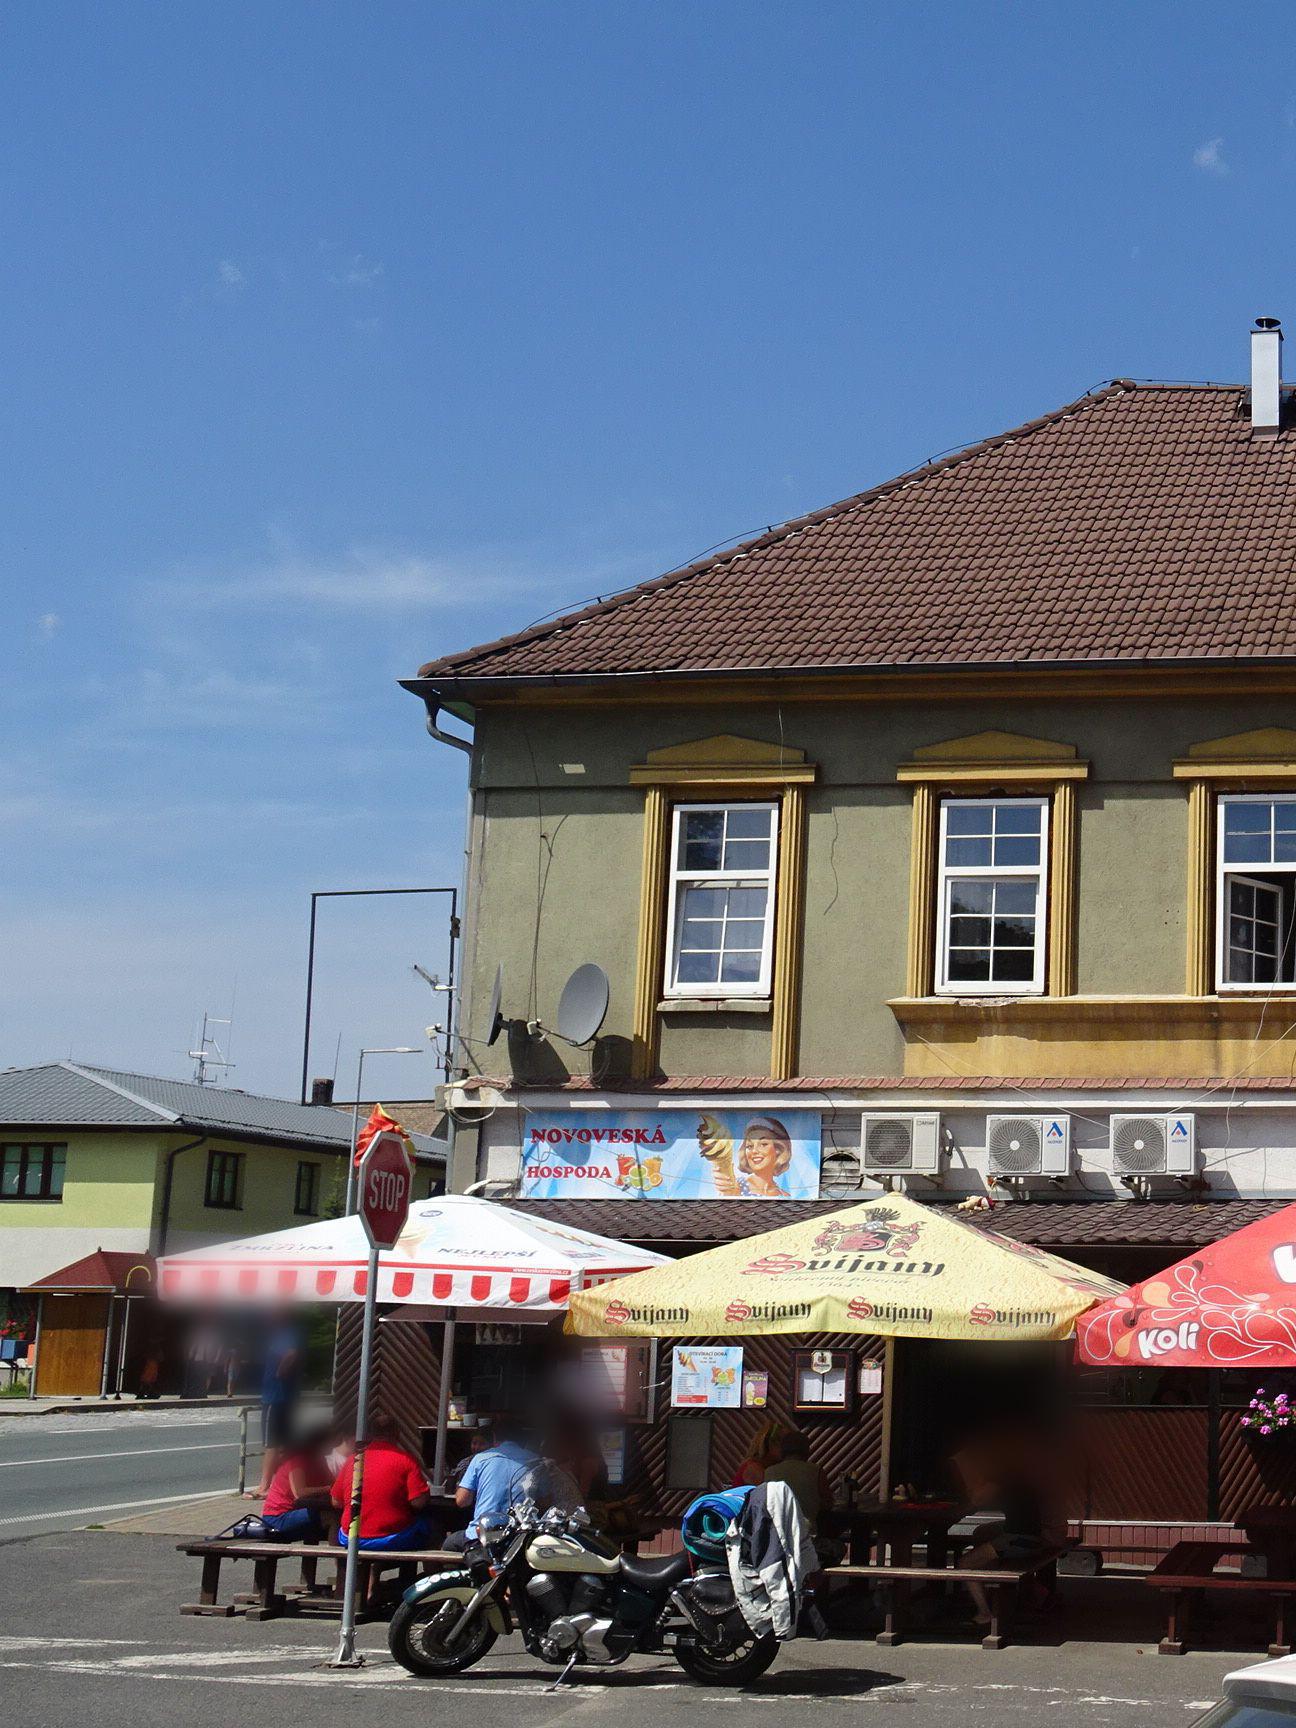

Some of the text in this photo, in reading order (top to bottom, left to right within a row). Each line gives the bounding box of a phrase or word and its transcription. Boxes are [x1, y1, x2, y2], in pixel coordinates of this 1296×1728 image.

[531, 1125, 666, 1144] NOVOVESKÁ
[527, 1166, 612, 1179] HOSPODA
[369, 1169, 405, 1212] STOP
[437, 1247, 539, 1258] NEJLEPŠÍ
[739, 1253, 946, 1277] Svijany
[605, 1299, 689, 1325] Svijany
[725, 1298, 811, 1322] Svijany
[847, 1296, 932, 1323] Svijany
[969, 1302, 1056, 1327] Svijany
